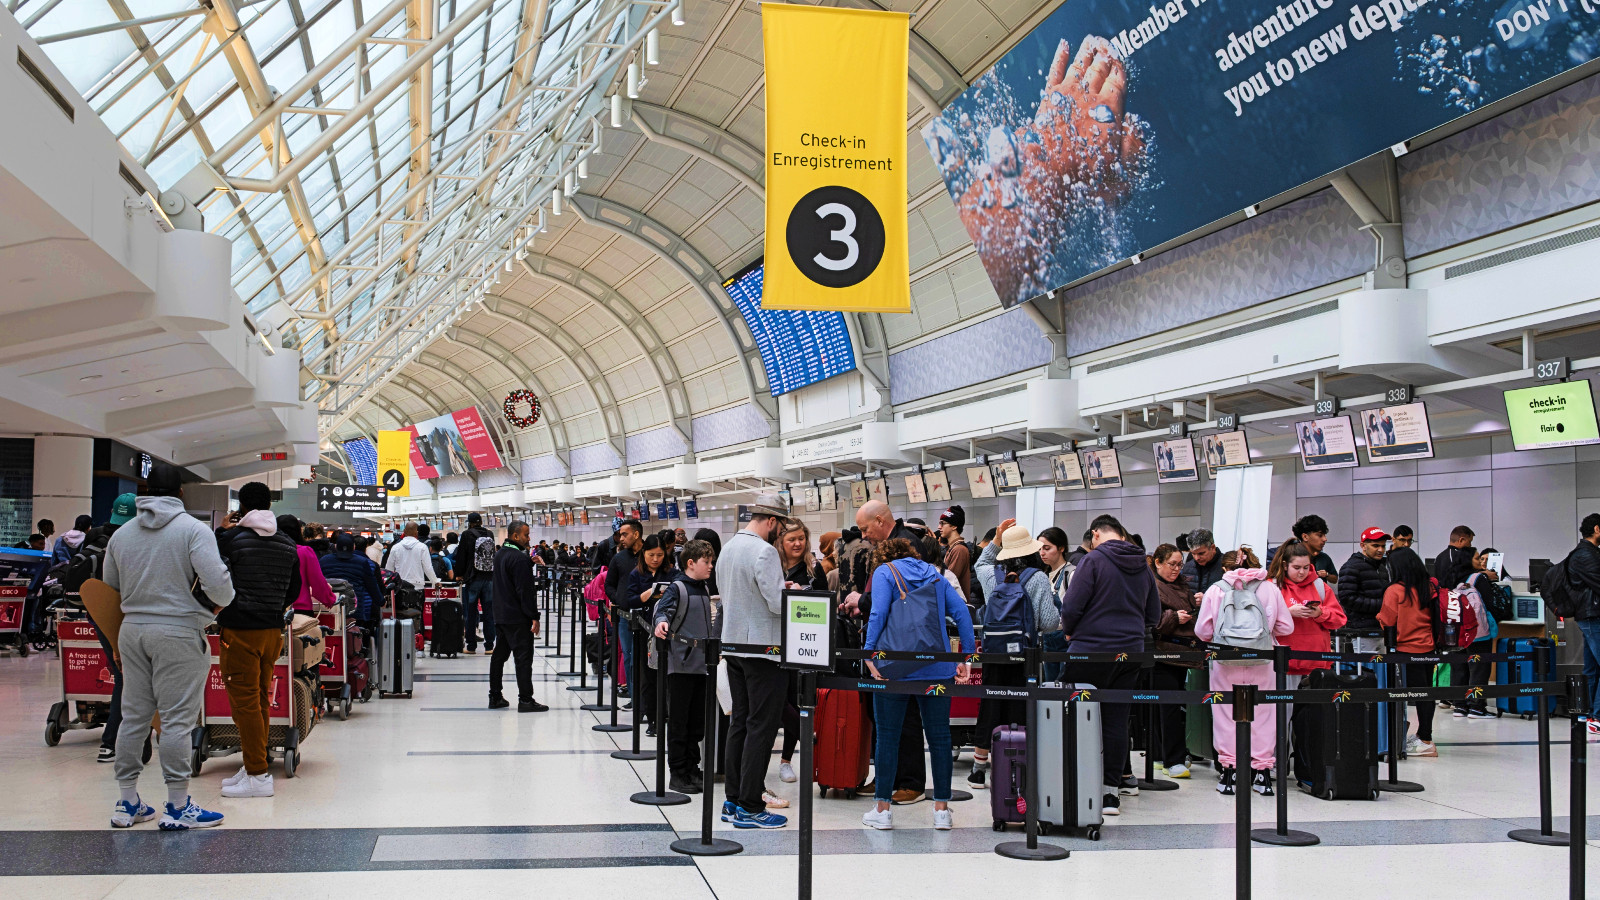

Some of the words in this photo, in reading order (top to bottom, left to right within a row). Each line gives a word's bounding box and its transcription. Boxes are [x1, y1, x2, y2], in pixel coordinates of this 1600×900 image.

[1111, 0, 1188, 60] Member
[1224, 72, 1270, 117] you
[1266, 57, 1294, 87] to
[1292, 24, 1348, 74] new
[801, 133, 866, 149] Check-in
[773, 153, 893, 171] Enregistrement
[813, 202, 860, 271] 3
[1537, 362, 1561, 379] 337
[1388, 388, 1406, 402] 338
[1316, 400, 1332, 414] 339
[1529, 395, 1567, 409] check-in
[1218, 416, 1233, 428] 340
[1540, 423, 1555, 432] flair
[1170, 424, 1180, 435] 341
[1062, 441, 1071, 451] 343
[1097, 436, 1107, 447] 342
[386, 472, 400, 488] 4
[74, 627, 95, 636] CIBC
[800, 633, 817, 641] EXIT
[798, 648, 818, 657] ONLY
[857, 682, 887, 690] bienvenue
[1519, 686, 1543, 694] welcome
[985, 688, 1007, 696] Toronto
[1007, 689, 1029, 697] Pearson
